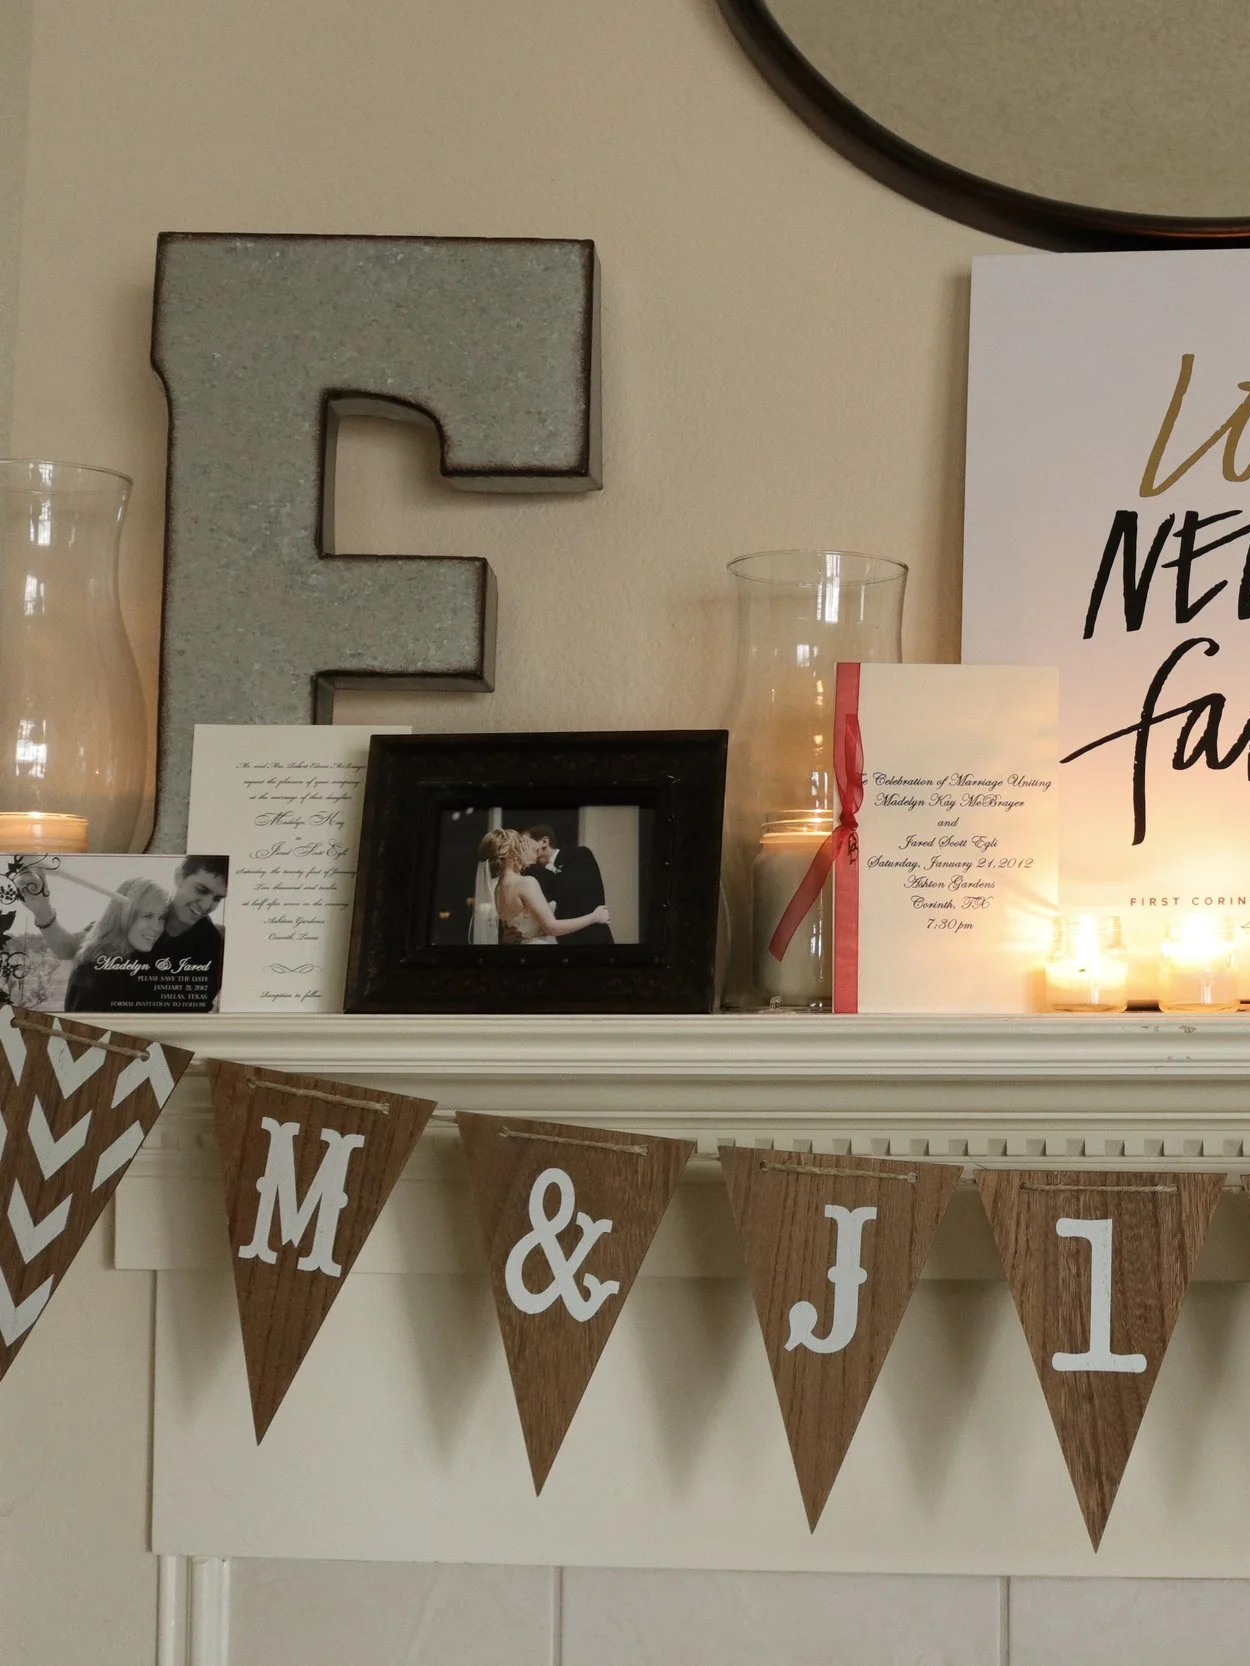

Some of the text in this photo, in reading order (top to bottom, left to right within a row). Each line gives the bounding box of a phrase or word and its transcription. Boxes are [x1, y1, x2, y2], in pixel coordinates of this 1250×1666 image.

[872, 772, 933, 787] Celebration
[936, 775, 950, 792] of
[948, 772, 1004, 792] Marriage
[1007, 773, 1052, 792] Uniting
[874, 793, 1025, 813] Madelyn Kay McBrayer
[937, 817, 960, 827] and
[898, 834, 999, 851] Jared Scott Egli
[867, 855, 921, 873] Saturday,
[923, 855, 973, 873] January
[904, 875, 996, 892] Ashton Gardens
[961, 895, 994, 910] TX
[1130, 897, 1180, 907] FIRST
[94, 955, 150, 976] Madelyn
[170, 957, 212, 974] Jared
[238, 1116, 364, 1278] M
[504, 1167, 620, 1322] &
[784, 1203, 877, 1354] J
